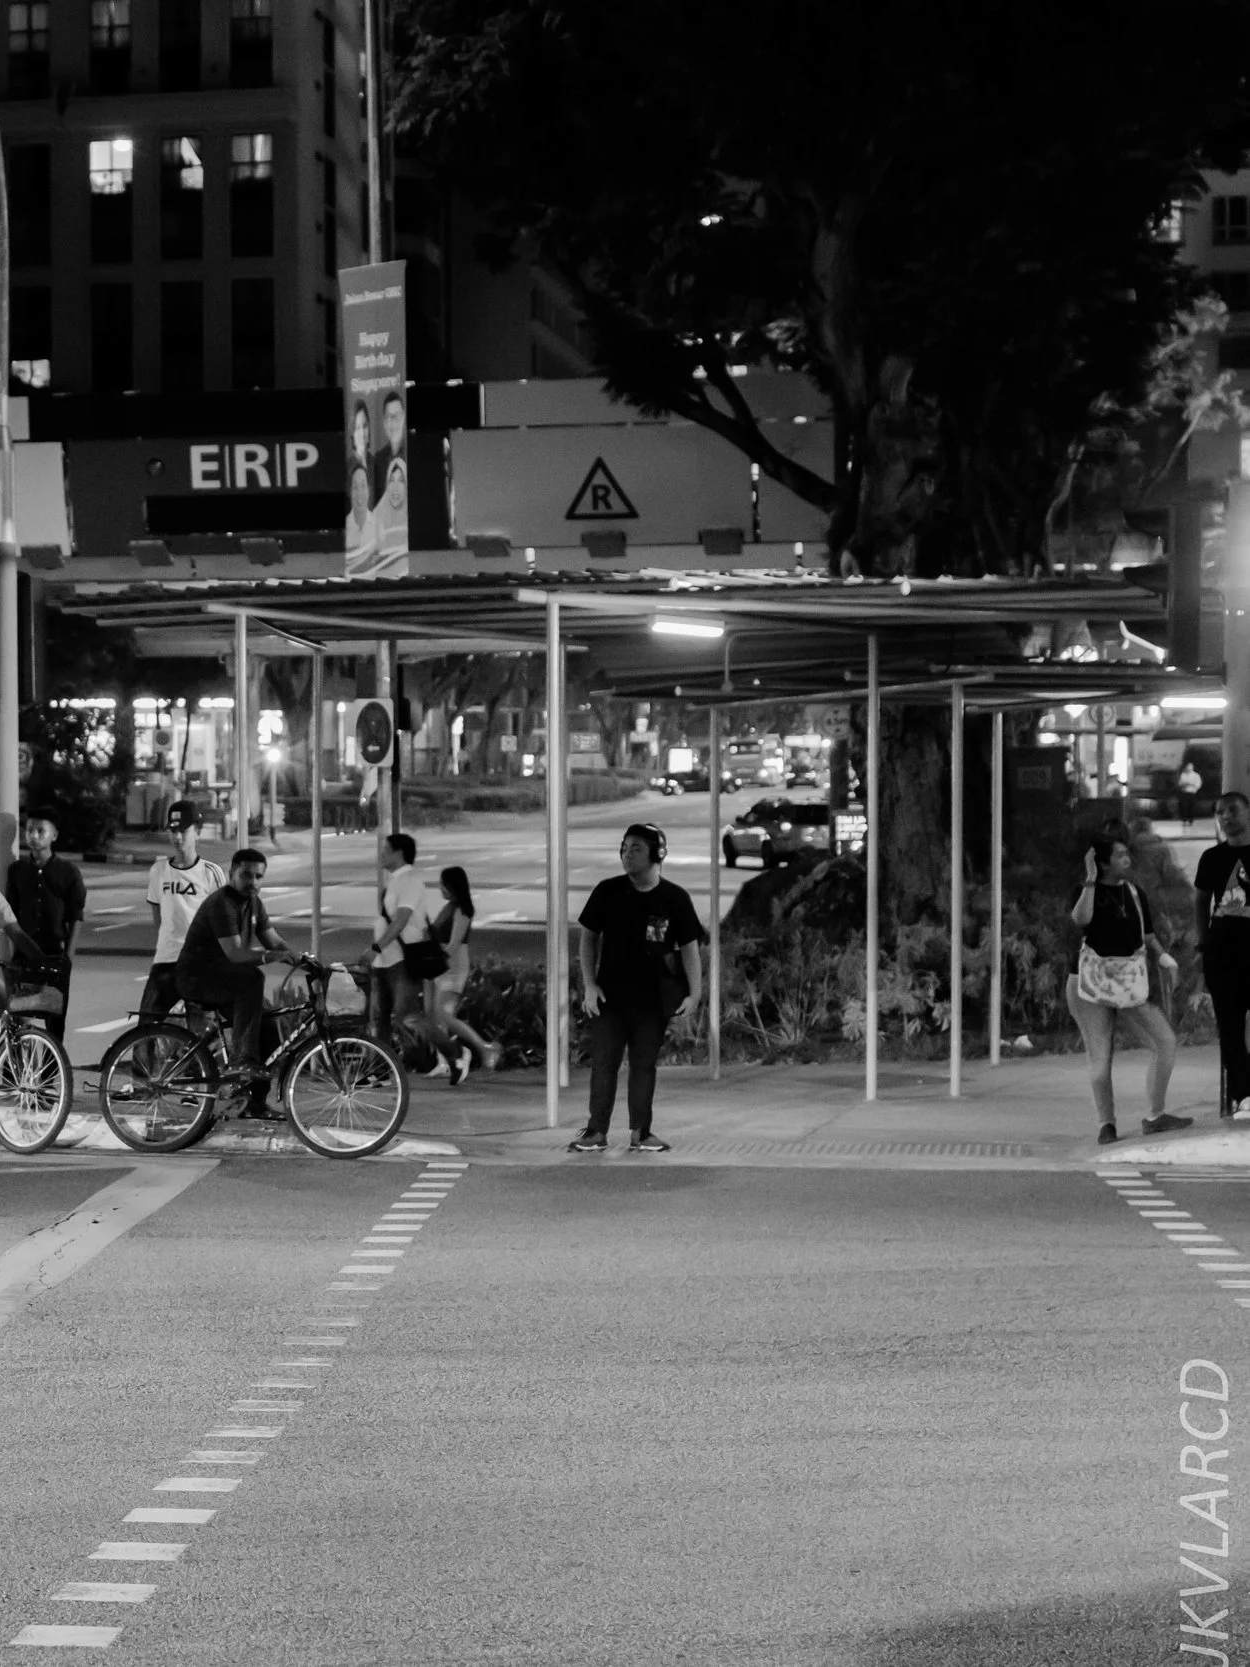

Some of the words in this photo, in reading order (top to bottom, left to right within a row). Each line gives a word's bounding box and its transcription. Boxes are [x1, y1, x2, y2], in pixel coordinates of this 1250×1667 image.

[359, 331, 390, 348] Happy
[355, 352, 397, 370] Birthday
[350, 372, 401, 394] Singapore!
[189, 442, 320, 489] ERP
[591, 484, 613, 510] R
[162, 881, 198, 896] FILA
